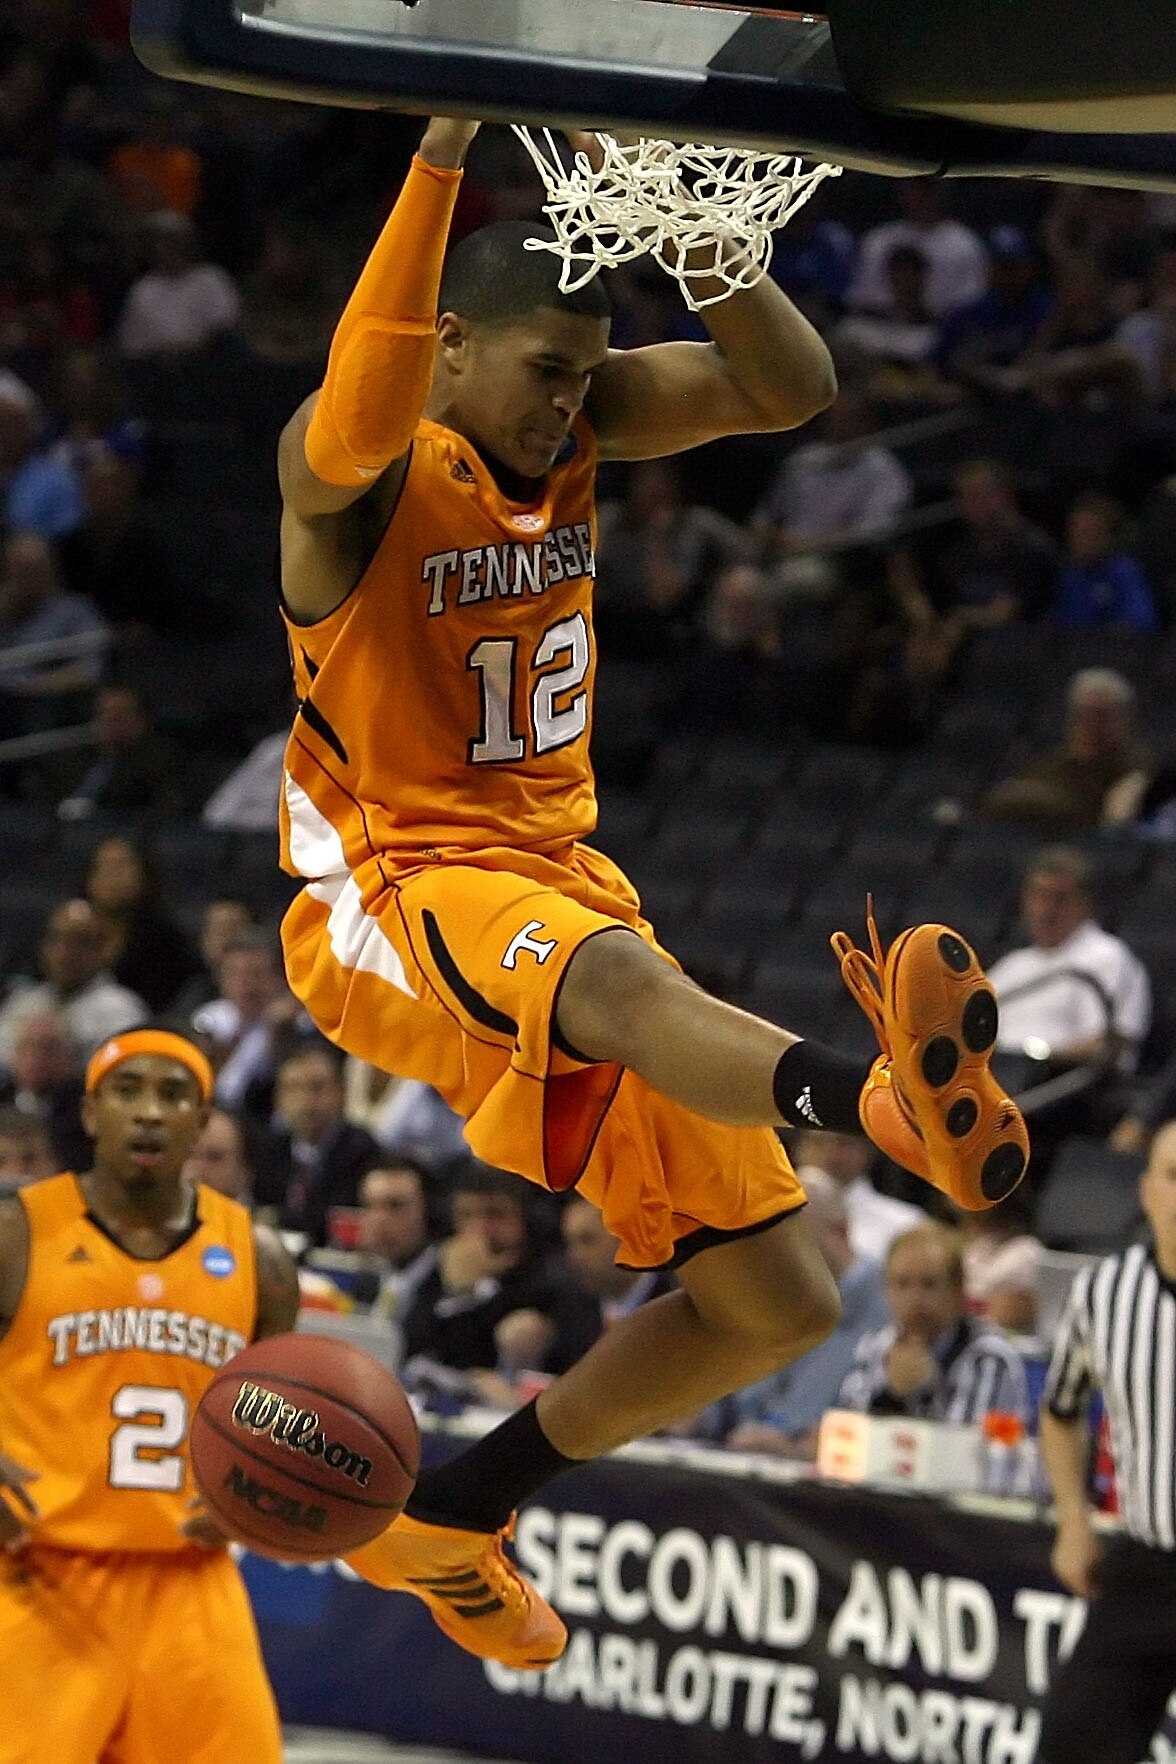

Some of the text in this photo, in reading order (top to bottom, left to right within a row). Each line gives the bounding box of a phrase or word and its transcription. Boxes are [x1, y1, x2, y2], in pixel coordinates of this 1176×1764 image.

[421, 523, 597, 617] TENNSSE
[465, 608, 590, 766] 12
[500, 919, 559, 971] T
[109, 1383, 189, 1492] 2
[231, 1379, 376, 1489] Wilson
[514, 1505, 820, 1649] SECOND
[827, 1558, 999, 1683] AND
[834, 1671, 1043, 1764] NORTH
